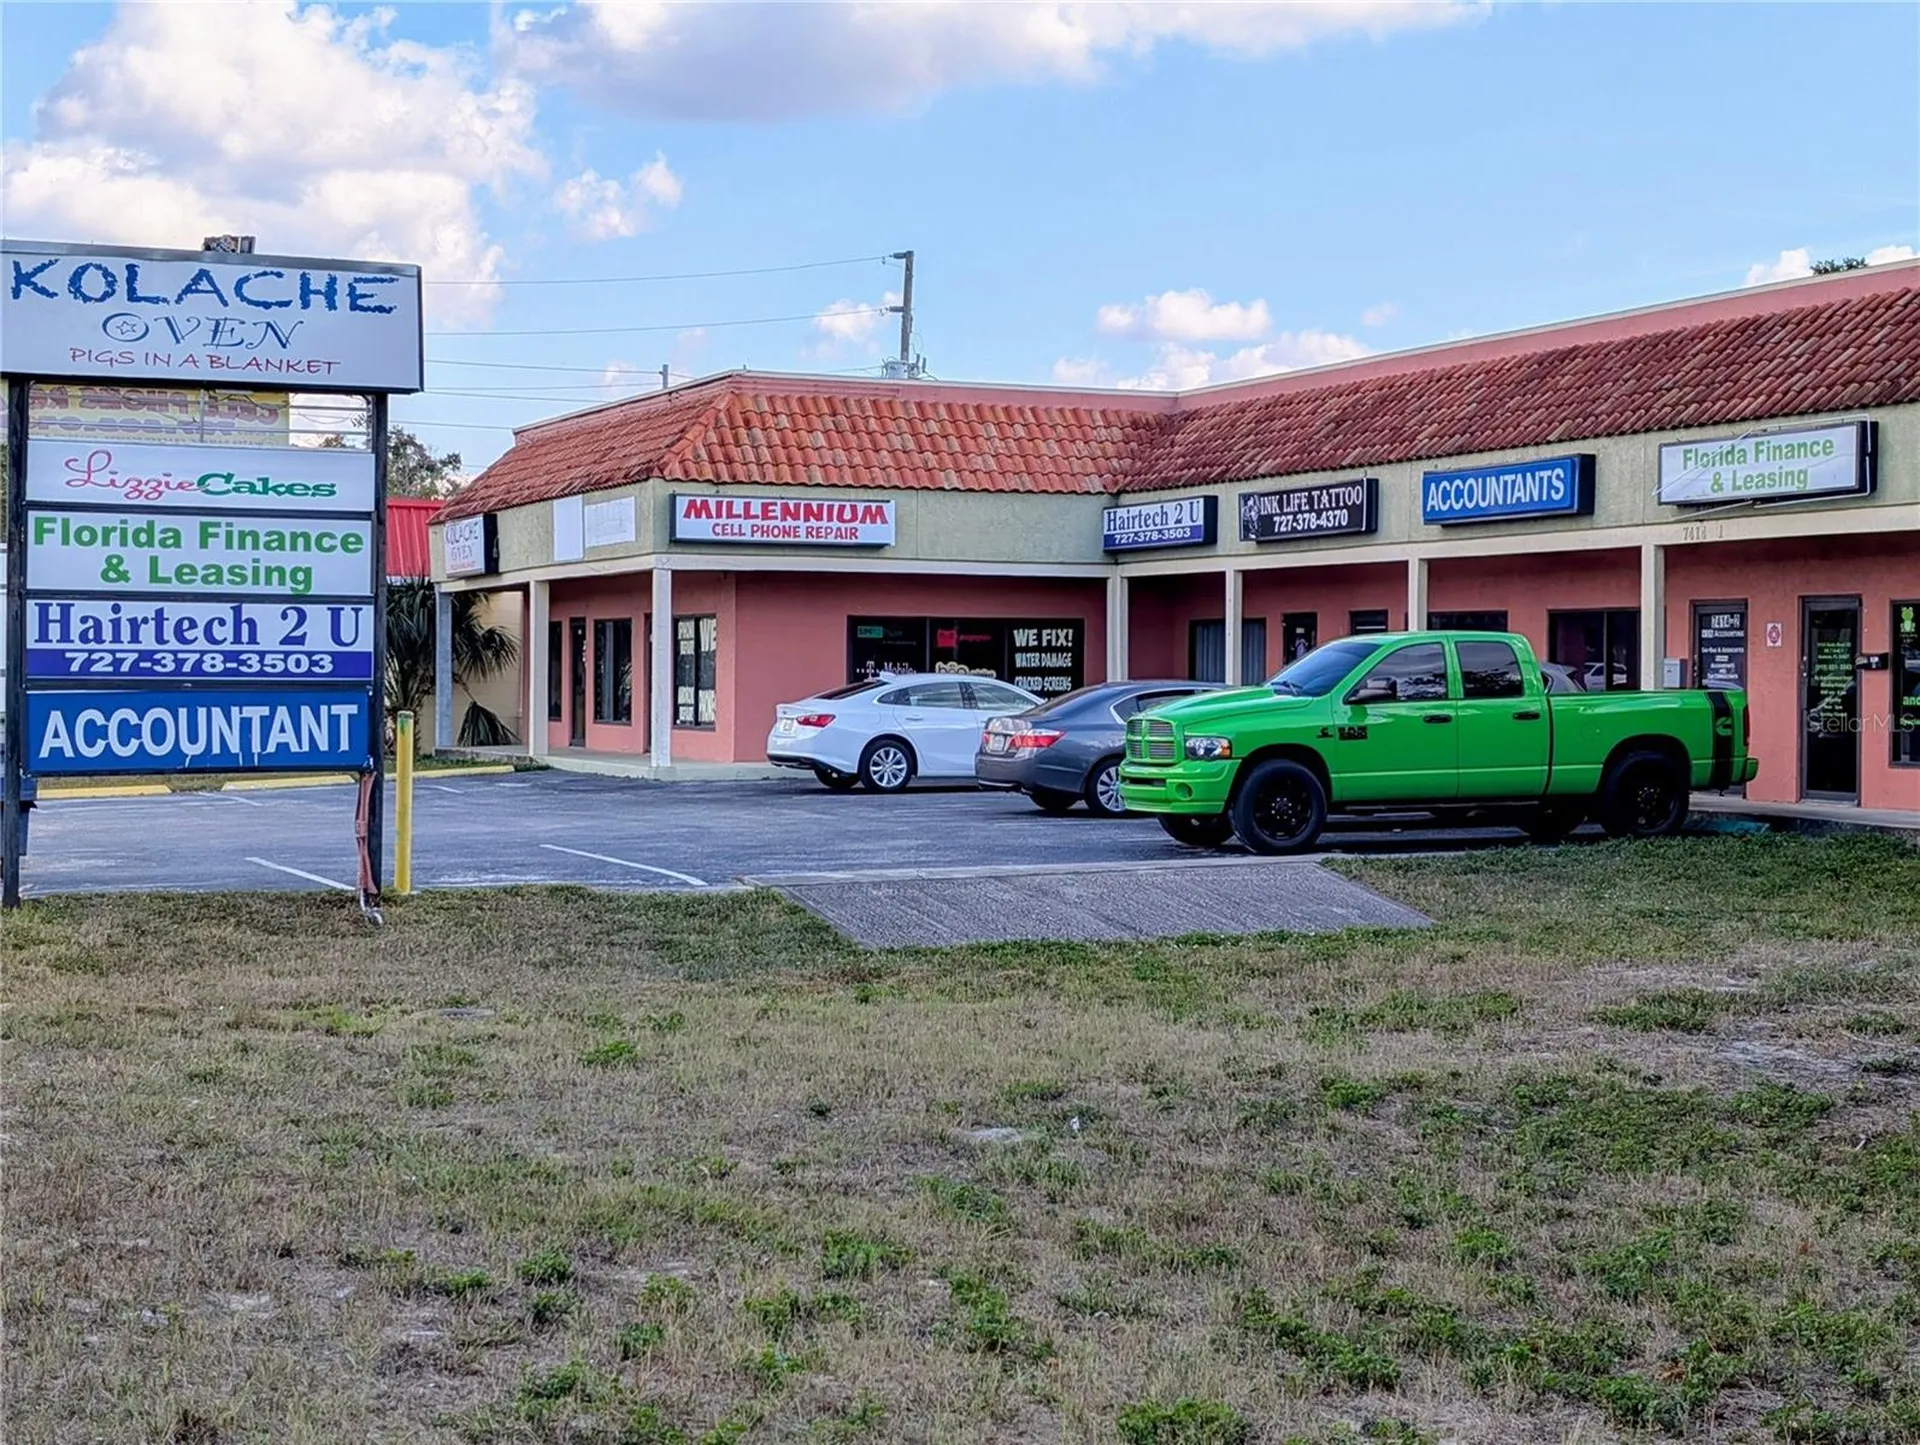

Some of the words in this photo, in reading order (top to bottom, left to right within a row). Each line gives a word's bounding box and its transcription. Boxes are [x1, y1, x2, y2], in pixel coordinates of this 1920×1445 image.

[11, 258, 399, 315] KOLACHE
[103, 312, 304, 349] OVEN
[70, 347, 134, 365] PIGS
[145, 352, 171, 368] IN
[182, 353, 200, 369] A
[209, 354, 341, 375] BLANKET
[1682, 444, 1748, 471] Florida
[1754, 439, 1834, 464] Finance
[1426, 467, 1565, 512] ACCOUNTANTS
[1710, 471, 1724, 493] &
[1732, 466, 1809, 491] Leasing
[683, 498, 889, 525] MILLENNIUM
[1260, 495, 1281, 515] INK
[1283, 491, 1310, 513] LIFE
[1311, 485, 1363, 510] TATTOO
[712, 522, 746, 537] CELL
[751, 524, 801, 539] PHONE
[805, 526, 859, 540] REPAIR
[1106, 505, 1169, 532] Hairtech
[1174, 503, 1184, 524] 2
[1189, 500, 1200, 523] U
[1273, 508, 1348, 533] 727-378-4370
[33, 516, 182, 548] Florida
[199, 520, 364, 554] Finance
[1114, 527, 1191, 544] 727-378-3503
[99, 554, 132, 584] &
[149, 555, 313, 596] Leasing
[33, 602, 260, 646] Hairtech
[279, 605, 308, 647] 2
[327, 606, 363, 647] U
[1013, 628, 1039, 648] WE
[1042, 628, 1074, 648] FIX!
[65, 652, 334, 674] 727-378-3503
[1015, 652, 1040, 668] WATER
[1041, 652, 1072, 668] DAMAGE
[39, 704, 358, 759] ACCOUNTANT
